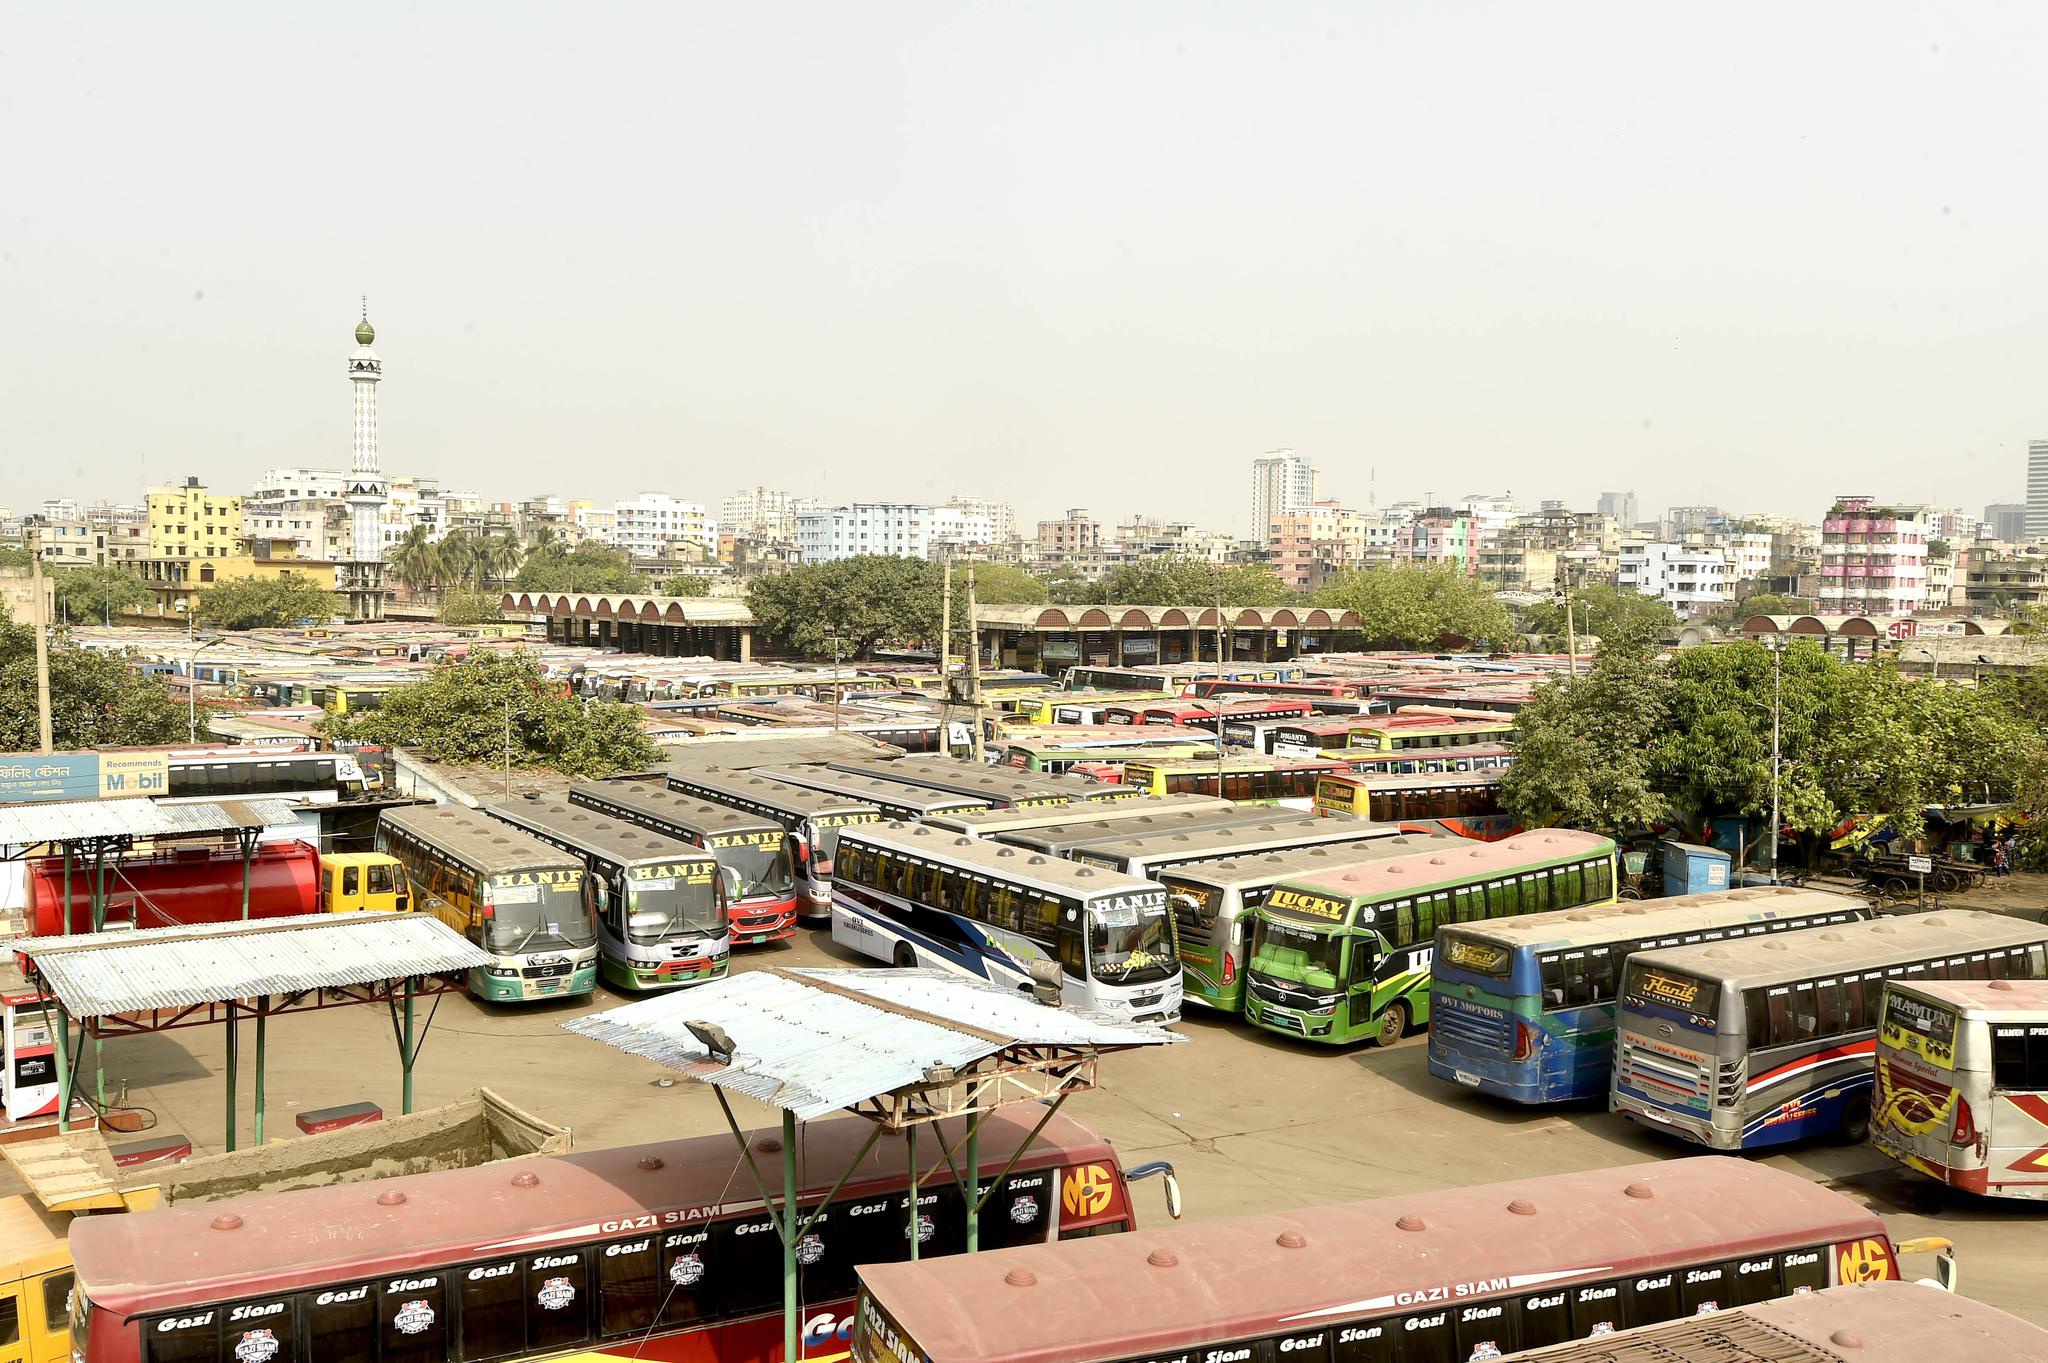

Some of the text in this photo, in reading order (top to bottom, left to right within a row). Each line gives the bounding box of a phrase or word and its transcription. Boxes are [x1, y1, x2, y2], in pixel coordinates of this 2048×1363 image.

[1280, 733, 1307, 742] DIGANTA
[107, 760, 162, 768] Recommends
[107, 773, 162, 790] Mbil
[1016, 797, 1068, 808] HANIF
[816, 813, 881, 828] HANIF
[712, 832, 784, 849] HANIF
[494, 870, 584, 888] HANIF
[634, 862, 716, 881] HANIF
[1093, 891, 1166, 912] HANIF
[1268, 890, 1346, 920] LUCKY
[1541, 954, 1559, 964] HANIF
[1564, 951, 1585, 960] SPECIAL
[1592, 947, 1609, 956] HANIF
[1660, 938, 1679, 946] SPECIAL
[1705, 932, 1723, 940] SPECIAL
[1749, 926, 1766, 934] SPECIAL
[1769, 987, 1789, 996] SPECIAL
[1797, 982, 1813, 991] HANIF
[1818, 979, 1836, 988] SPECIAL
[1843, 975, 1859, 983] HANIF
[1864, 971, 1882, 980] SPECIAL
[1907, 964, 1925, 973] SPECIAL
[1949, 957, 1966, 966] SPECIAL
[1989, 951, 2005, 959] SPECIAL
[1643, 973, 1697, 1002] Hanif
[1441, 995, 1504, 1019] OVI MOTORS
[1641, 991, 1692, 1008] ENTERPRISE
[1890, 995, 1953, 1028] MAMUN
[1997, 1028, 2025, 1037] MAMUN
[1913, 1061, 1938, 1077] Special
[1013, 1205, 1038, 1217] GAZI SIAM
[602, 1204, 719, 1238] GAZI SIAM
[158, 1311, 213, 1332] Gazi
[230, 1302, 285, 1321] Siam
[316, 1286, 369, 1305] Gazi
[387, 1276, 438, 1294] Siam
[468, 1262, 516, 1281] Gazi
[531, 1253, 579, 1271] Siam
[605, 1239, 650, 1257] Gazi
[665, 1231, 709, 1248] Siam
[735, 1219, 775, 1236] Gazi
[849, 1200, 887, 1217] Gazi
[901, 1194, 939, 1209] Sam
[1008, 1176, 1044, 1194] Siam
[810, 1246, 824, 1255] SIAM
[672, 1265, 703, 1278] GAZI SIAM
[540, 1289, 573, 1303] GAZI SIAM
[1396, 1278, 1508, 1305] GAZI SIAM
[1206, 1348, 1251, 1363] Siam
[1280, 1334, 1324, 1353] Gazi
[1339, 1326, 1382, 1344] Siam
[1404, 1313, 1446, 1331] Gazi
[1461, 1306, 1502, 1323] Siam
[1526, 1293, 1565, 1311] Gazi
[1578, 1287, 1617, 1303] Siam
[1636, 1275, 1672, 1292] Gazi
[1686, 1269, 1722, 1287] Siam
[1739, 1258, 1773, 1275] Gazi
[1784, 1252, 1818, 1268] Siam
[397, 1312, 434, 1327] GAZI SIAM
[864, 1296, 886, 1340] GAZI
[240, 1343, 275, 1359] GAZI SIAM
